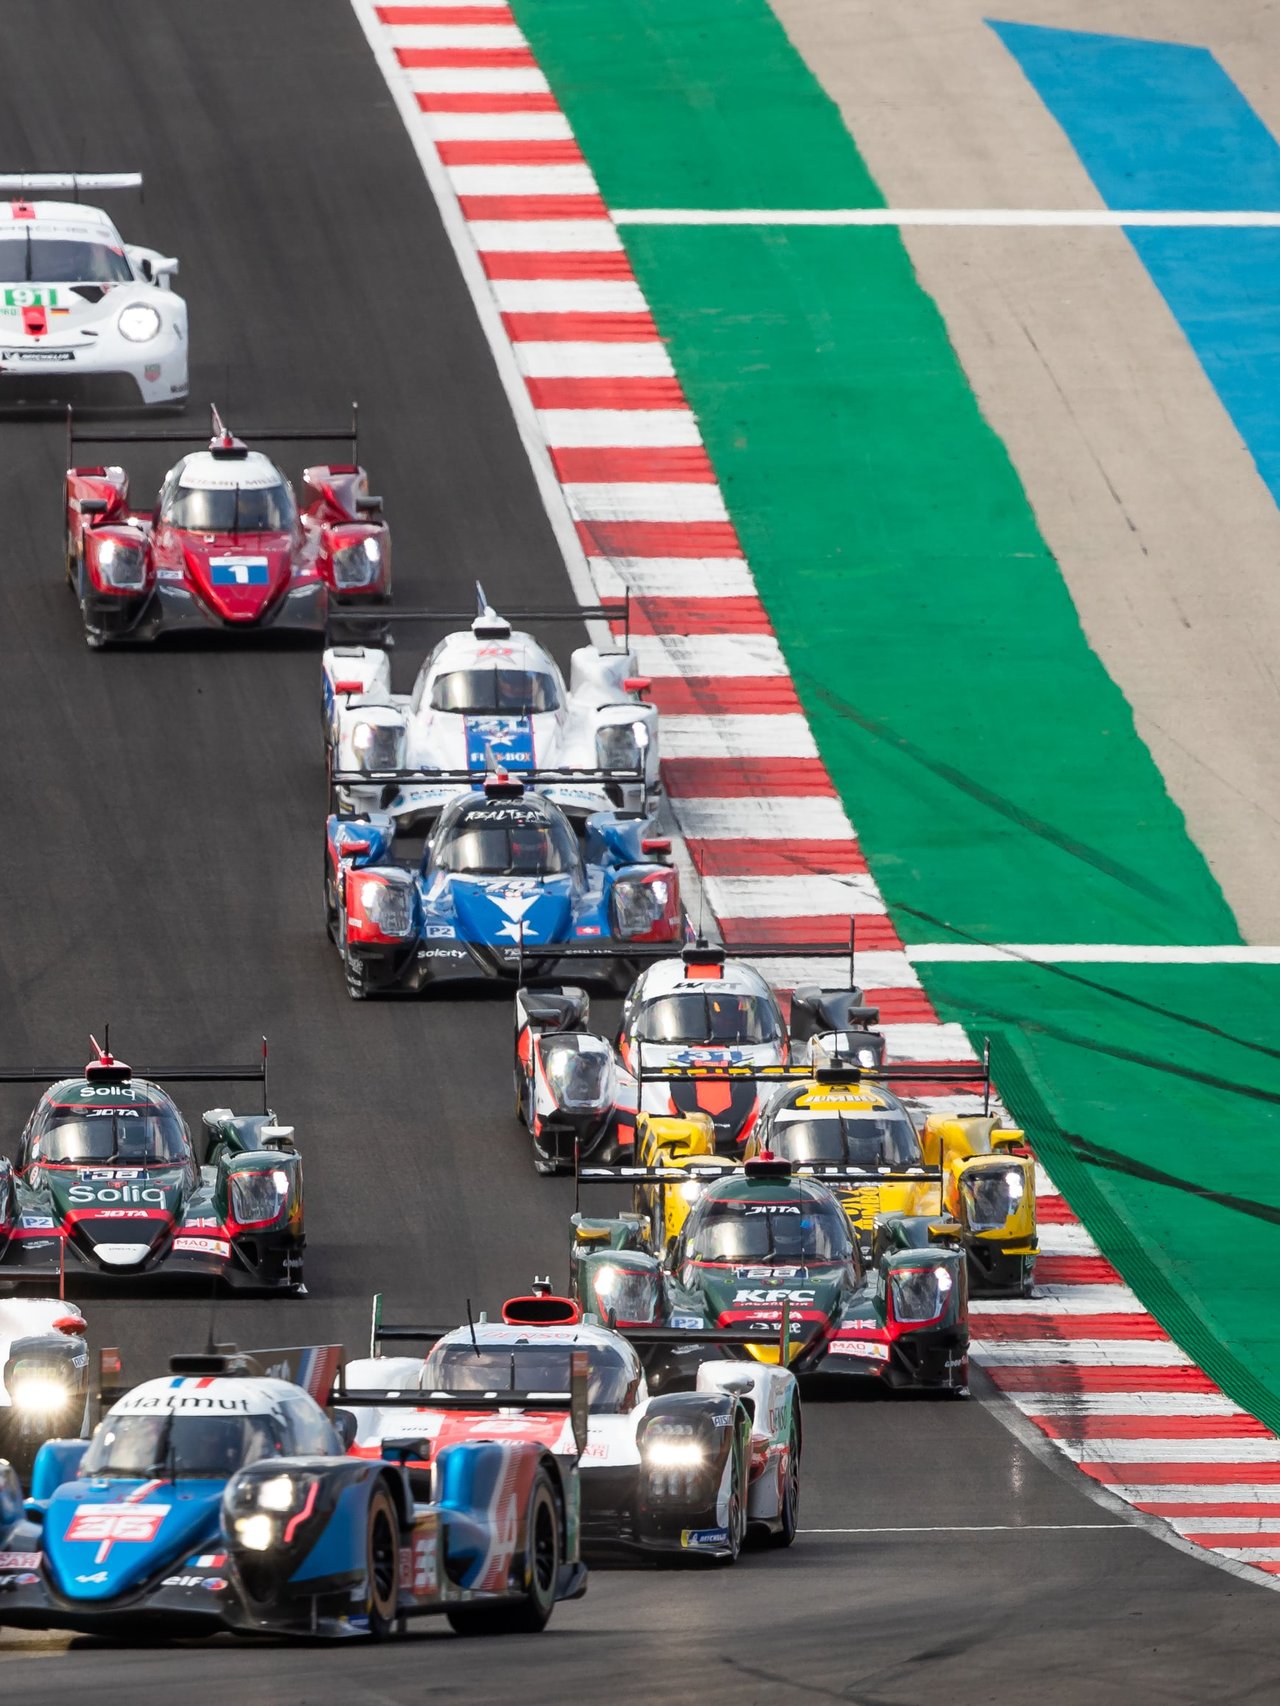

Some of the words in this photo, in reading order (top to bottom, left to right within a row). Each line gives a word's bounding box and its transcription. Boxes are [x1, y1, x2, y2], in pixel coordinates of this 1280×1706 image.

[11, 288, 51, 306] 91
[228, 565, 249, 584] 1
[428, 928, 453, 937] P2
[417, 949, 468, 959] solcity
[673, 982, 743, 990] WRT
[80, 1087, 136, 1101] Soliq
[68, 1186, 171, 1210] Soliq
[94, 1210, 149, 1218] JOTA
[24, 1217, 51, 1226] P2
[732, 1289, 817, 1303] KFC
[746, 1310, 804, 1320] JOA
[674, 1318, 700, 1328] P2
[161, 1575, 204, 1588] elf
